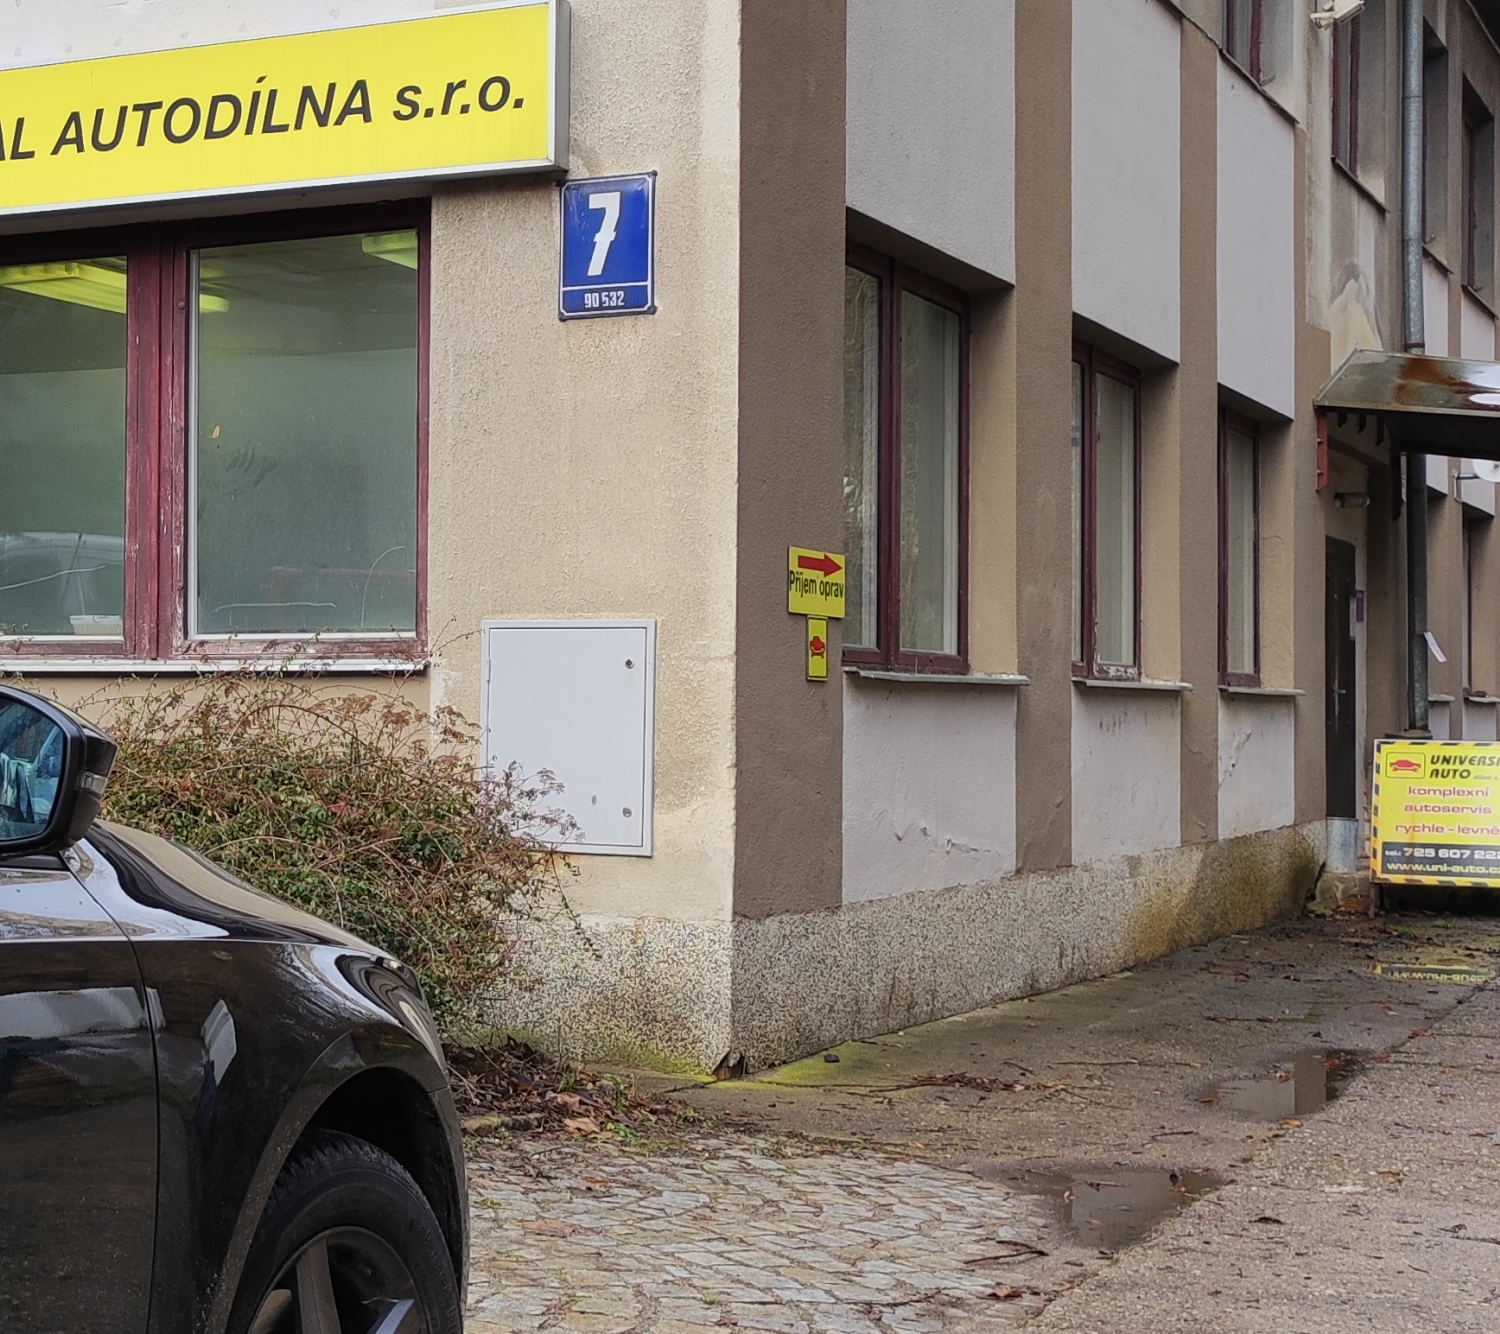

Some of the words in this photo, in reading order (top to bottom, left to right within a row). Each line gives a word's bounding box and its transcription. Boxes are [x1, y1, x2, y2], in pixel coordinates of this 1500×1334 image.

[51, 76, 374, 157] AUTODÍLNA
[393, 75, 526, 122] s.r.o.
[587, 192, 621, 276] 7
[601, 290, 625, 307] 532
[818, 578, 844, 602] oprav
[1429, 768, 1472, 780] AUTO
[1408, 786, 1490, 798] komplexní
[1404, 803, 1493, 814] autoservis
[1395, 822, 1445, 834] rychle
[1402, 847, 1436, 858] 725
[1438, 848, 1472, 859] 607
